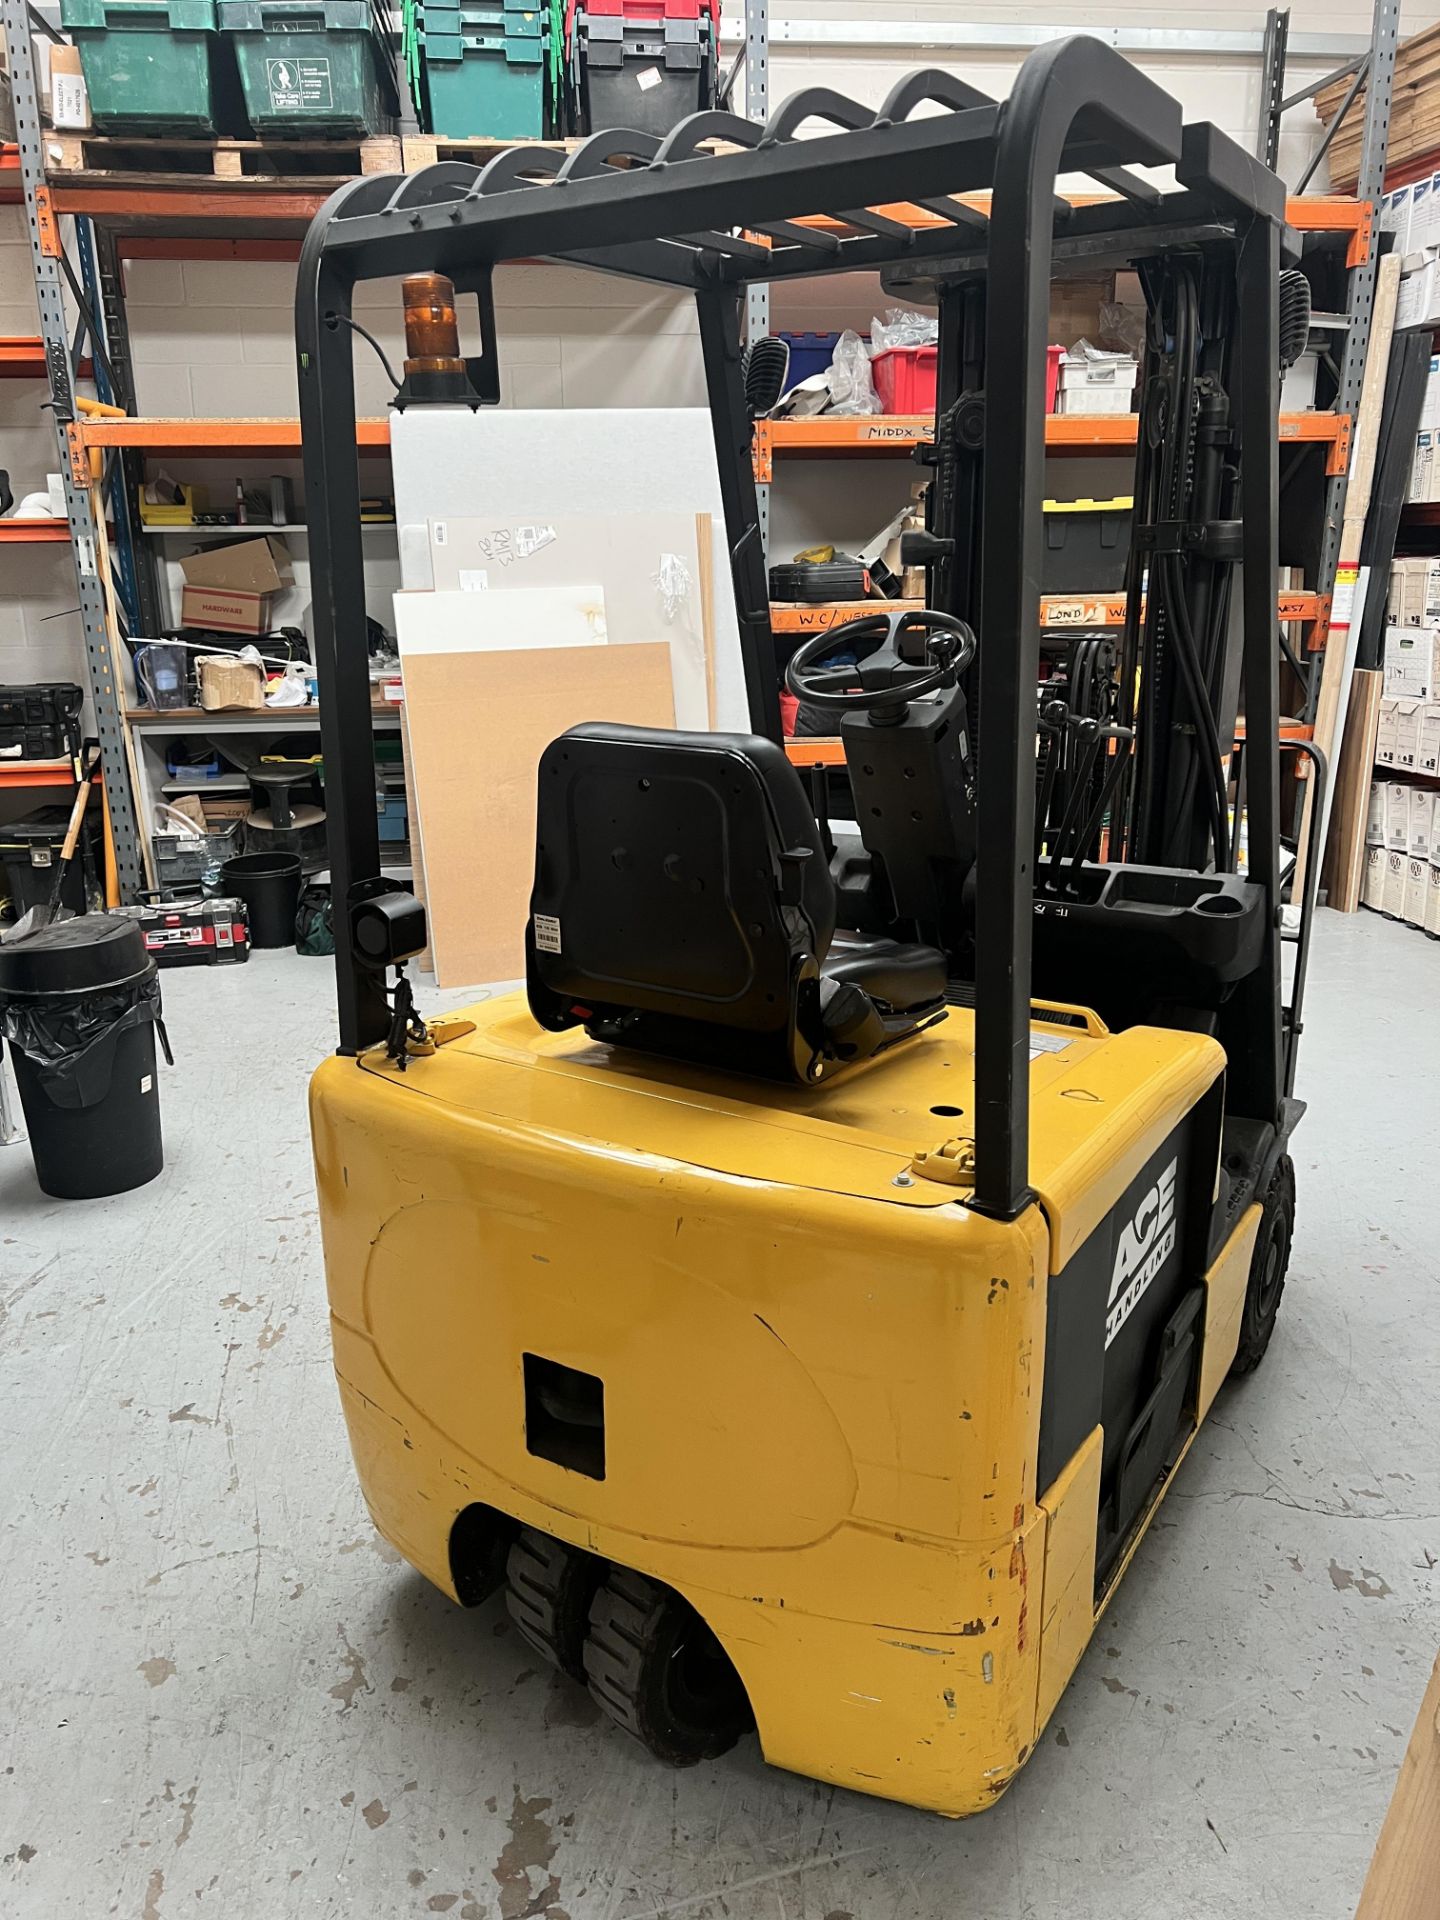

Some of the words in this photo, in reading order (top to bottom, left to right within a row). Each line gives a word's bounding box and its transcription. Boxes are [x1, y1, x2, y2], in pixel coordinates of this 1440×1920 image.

[202, 604, 243, 615] HARDWARE
[1105, 1232, 1173, 1338] HANDLING
[1107, 1155, 1177, 1309] ACE
